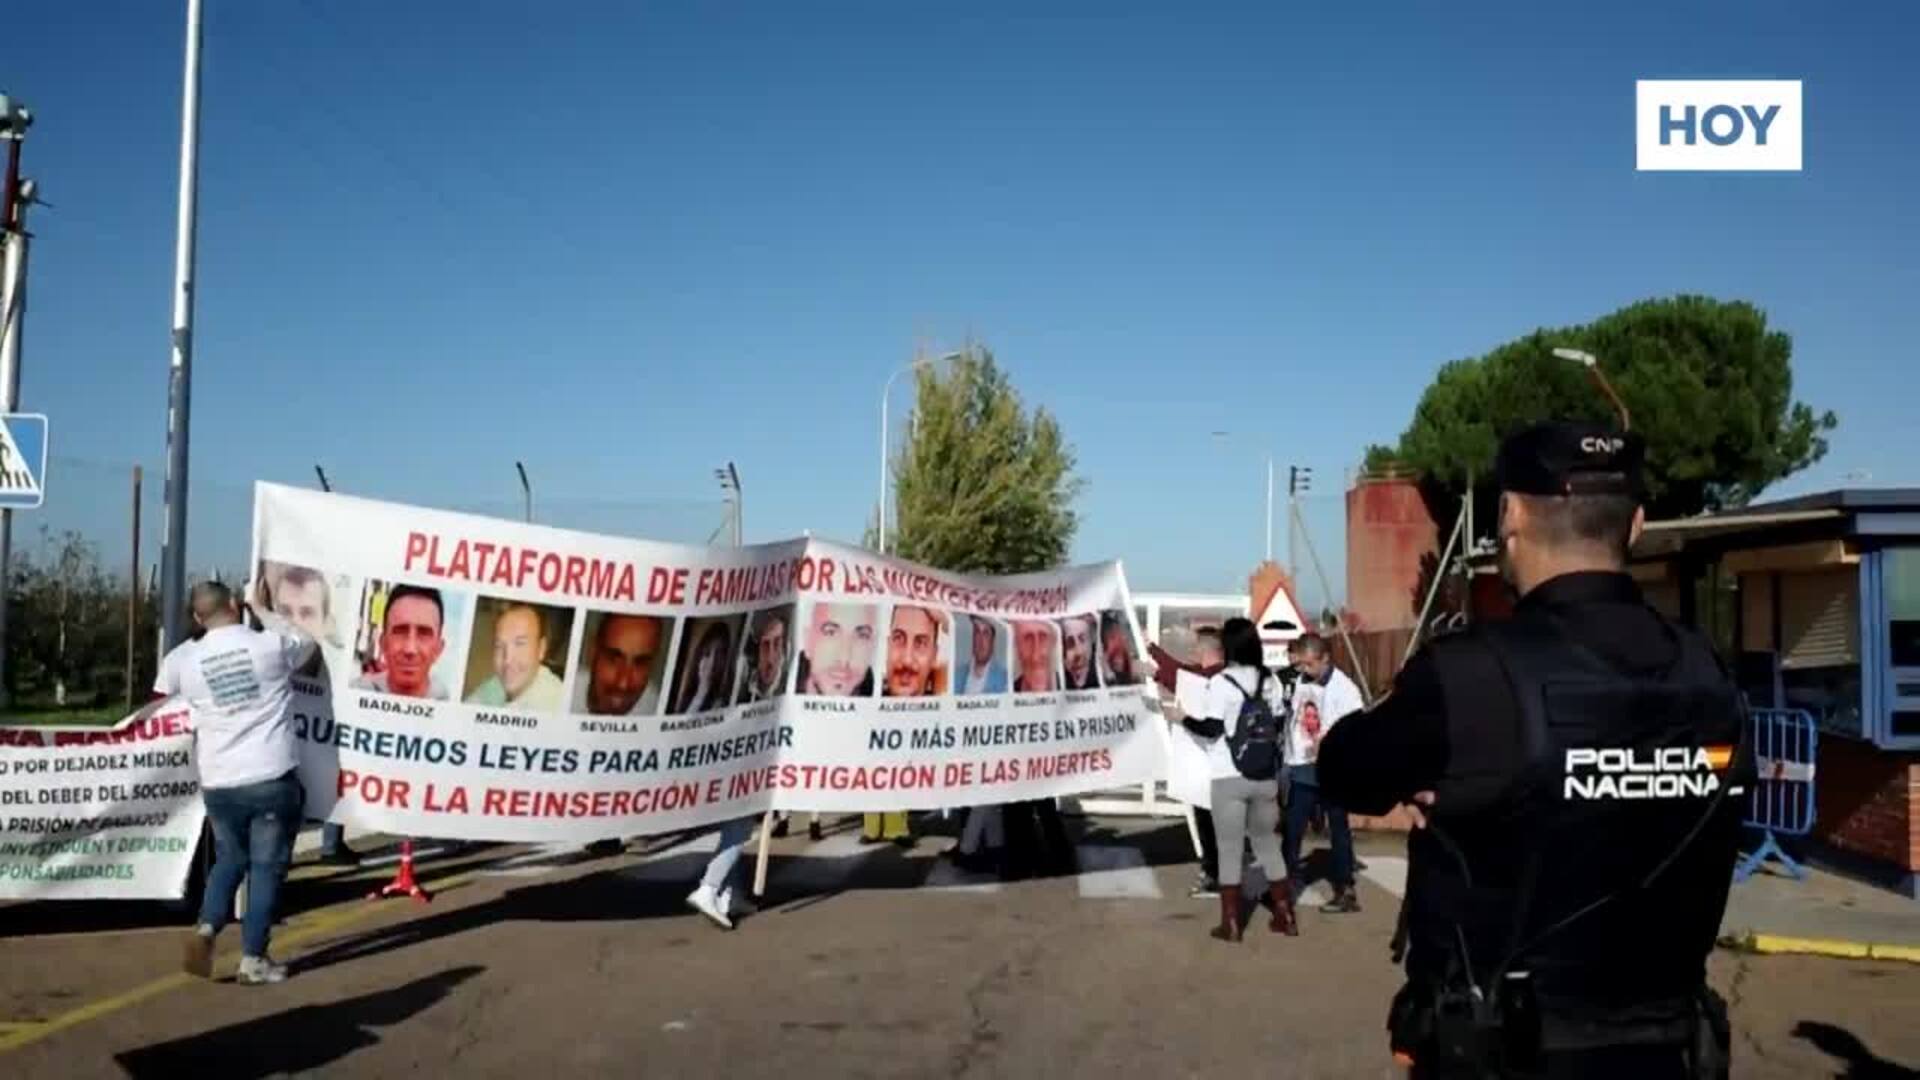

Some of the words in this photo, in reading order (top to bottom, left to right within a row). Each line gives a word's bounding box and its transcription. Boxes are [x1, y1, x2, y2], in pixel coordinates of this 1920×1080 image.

[1581, 437, 1624, 454] CNP
[404, 531, 635, 600] PLATAFORMA
[648, 566, 689, 604] DE
[696, 559, 786, 606] FAMILIAS
[787, 556, 834, 594] POR
[842, 560, 884, 594] LAS
[359, 697, 435, 718] BADAJOZ
[803, 701, 856, 713] SEVILLA
[475, 712, 538, 729] MADRID
[580, 720, 639, 733] SEVILLA
[660, 714, 725, 733] BARCELONA
[868, 729, 903, 750] NO
[910, 722, 956, 750] MÁS
[961, 721, 1050, 748] MUERTES
[1055, 718, 1075, 740] EN
[1079, 711, 1136, 736] PRISIÓN
[293, 712, 468, 767] QUEREMOS
[479, 743, 579, 774] LEYES
[588, 749, 659, 774] PARA
[667, 724, 794, 770] REINSERTAR
[14, 758, 49, 775] POR
[55, 754, 129, 773] DEJADEZ
[1565, 747, 1713, 773] POLICIA
[336, 767, 411, 809] POR
[423, 784, 469, 815] LA
[483, 779, 699, 819] REINSERCIÓN
[706, 778, 722, 804] E
[727, 760, 937, 800] INVESTIGACIÓN
[943, 761, 974, 788] DE
[980, 757, 1020, 785] LAS
[1026, 748, 1113, 781] MUERTES
[3, 790, 34, 805] DEL
[38, 787, 93, 804] DEBER
[99, 784, 129, 801] DEL
[8, 814, 74, 834] PRISIÓN
